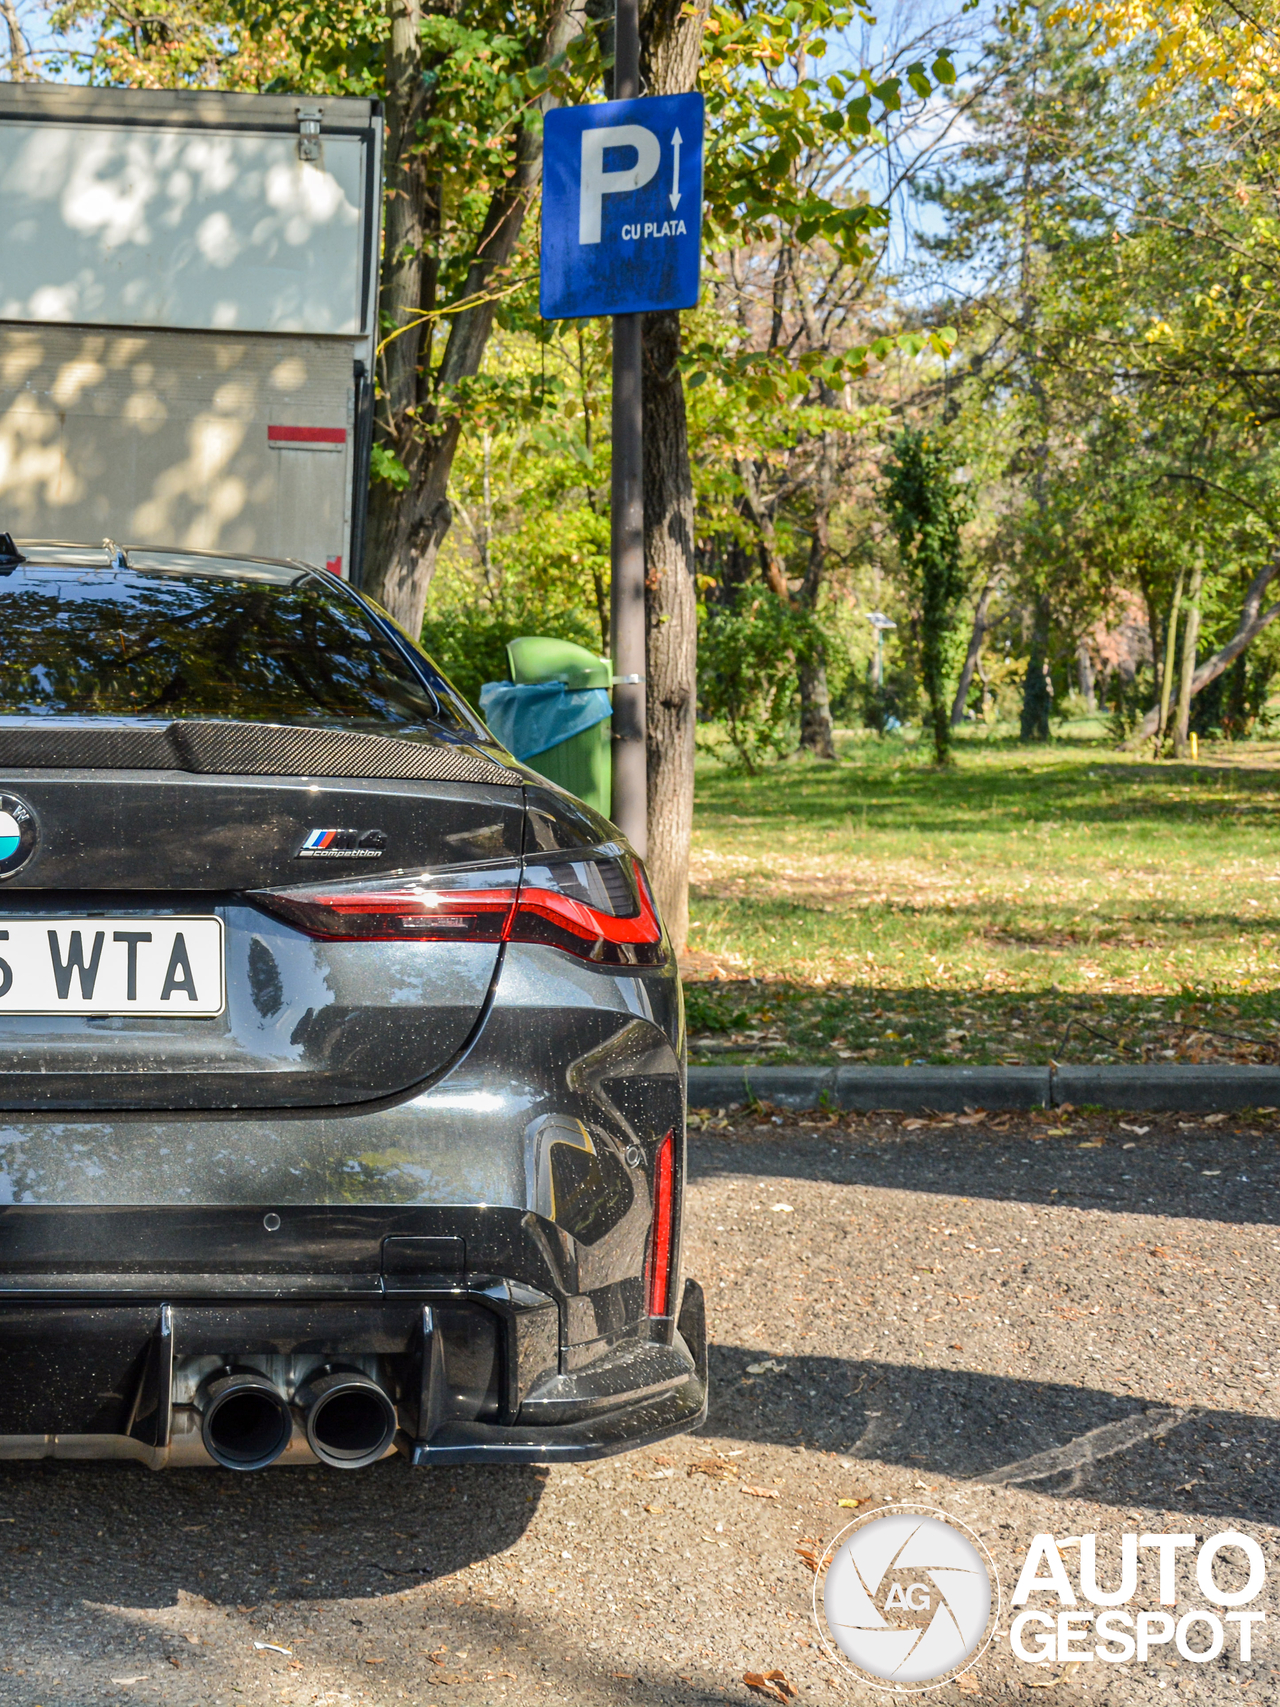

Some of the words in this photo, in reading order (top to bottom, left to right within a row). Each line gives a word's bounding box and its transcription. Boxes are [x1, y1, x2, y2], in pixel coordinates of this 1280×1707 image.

[579, 124, 661, 245] P
[621, 223, 641, 241] CU
[644, 220, 687, 239] PLATA
[313, 849, 382, 857] competition
[47, 930, 199, 1001] WTA
